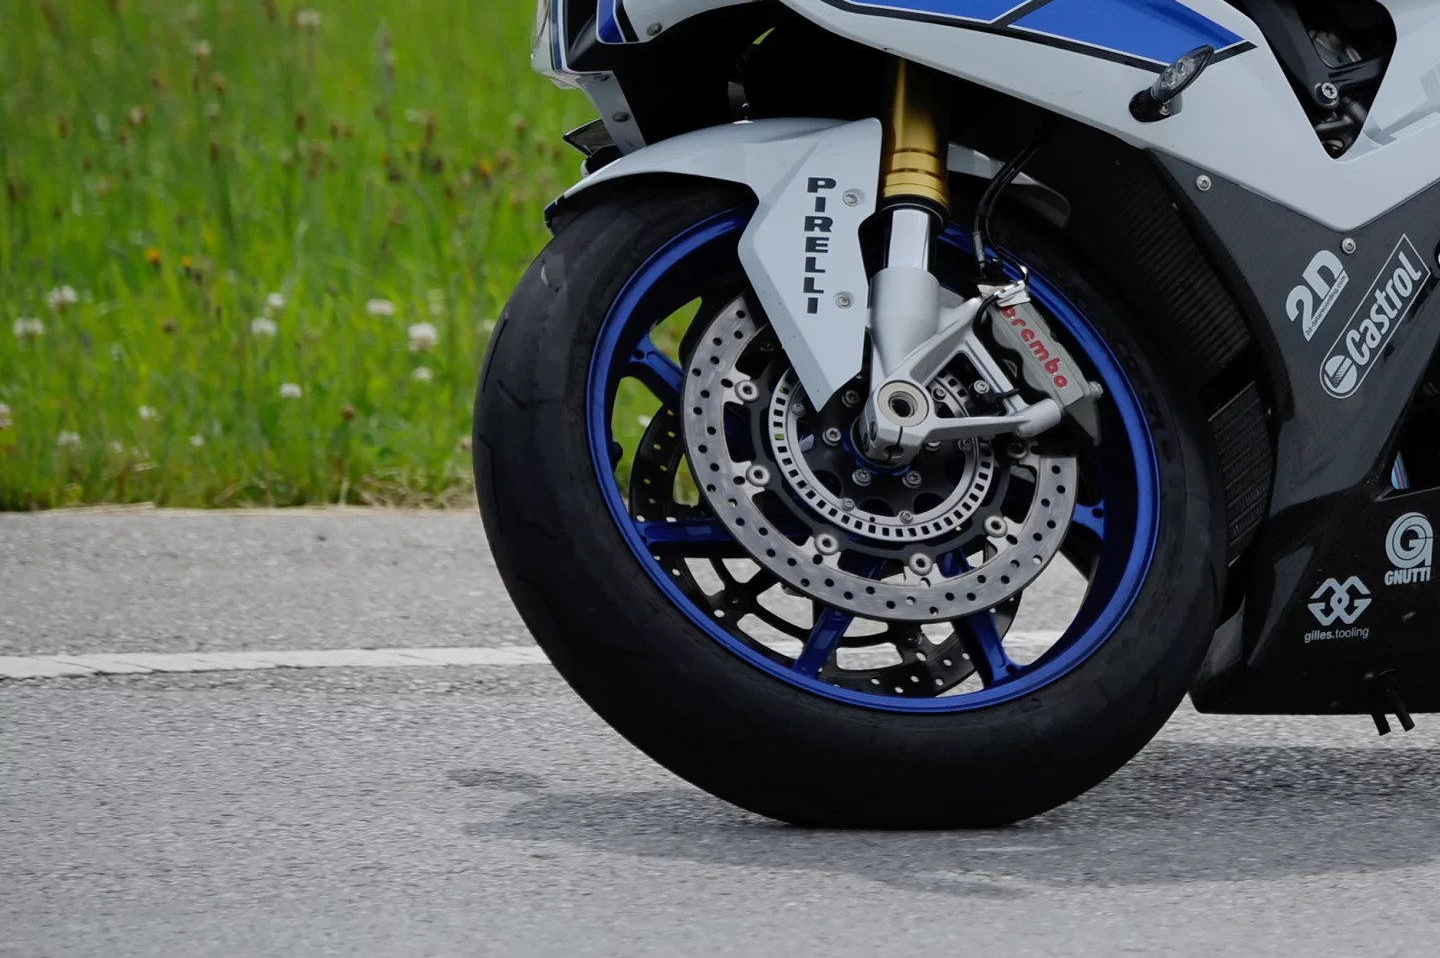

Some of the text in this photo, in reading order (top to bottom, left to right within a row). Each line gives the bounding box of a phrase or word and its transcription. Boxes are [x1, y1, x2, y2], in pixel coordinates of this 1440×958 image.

[803, 177, 837, 314] PIRELLI
[1345, 250, 1423, 366] Castrol
[1384, 566, 1432, 586] GNUTTI
[1303, 626, 1370, 643] gilles.tooling
